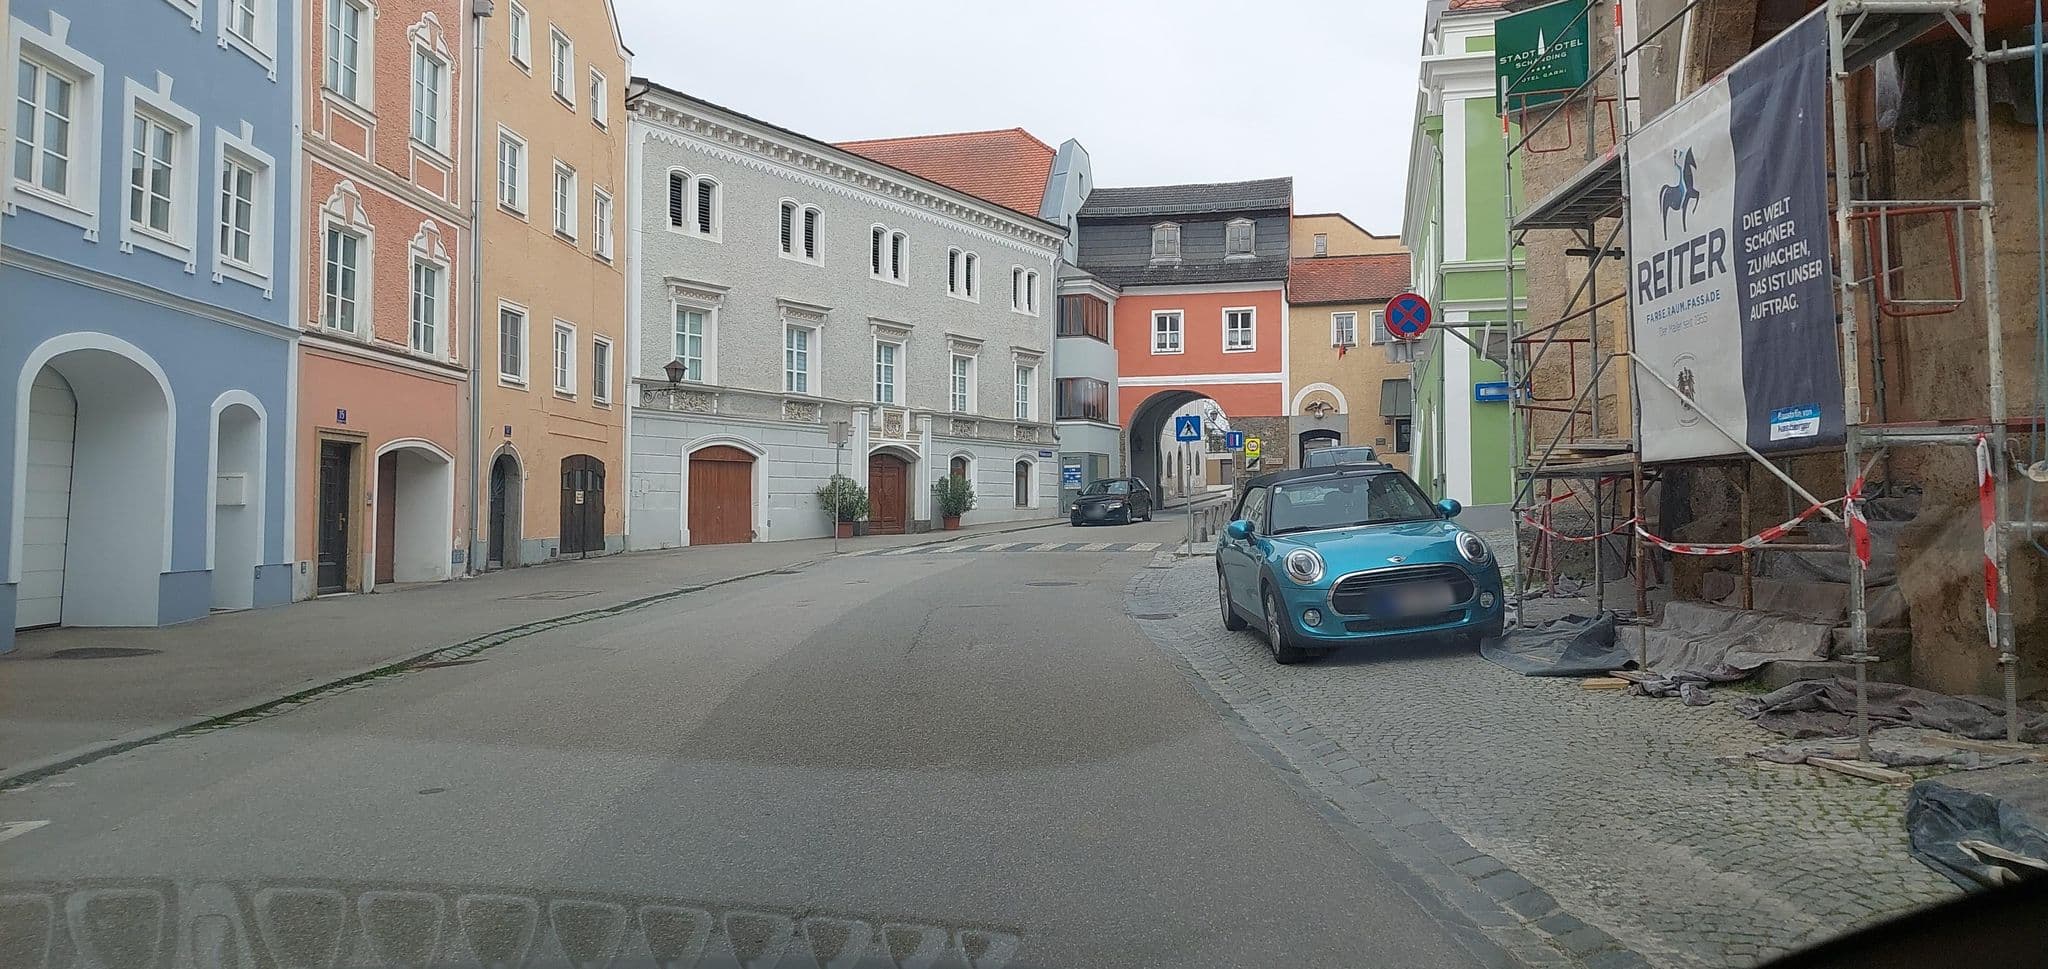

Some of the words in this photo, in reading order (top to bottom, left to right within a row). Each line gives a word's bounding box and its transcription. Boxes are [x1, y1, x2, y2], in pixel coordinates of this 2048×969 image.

[1500, 49, 1537, 65] STADT
[1515, 52, 1567, 69] SCHDING
[1743, 209, 1762, 231] DIE
[1763, 196, 1791, 222] WELT
[1745, 220, 1796, 253] SCHÖNER
[1637, 227, 1727, 305] REITER
[1747, 256, 1762, 276] ZU
[1762, 239, 1811, 271] MACHEN,
[1750, 277, 1767, 299] DAS
[1768, 271, 1787, 292] IST
[1787, 259, 1823, 286] UNSER
[1750, 293, 1800, 321] AUFTRAG.
